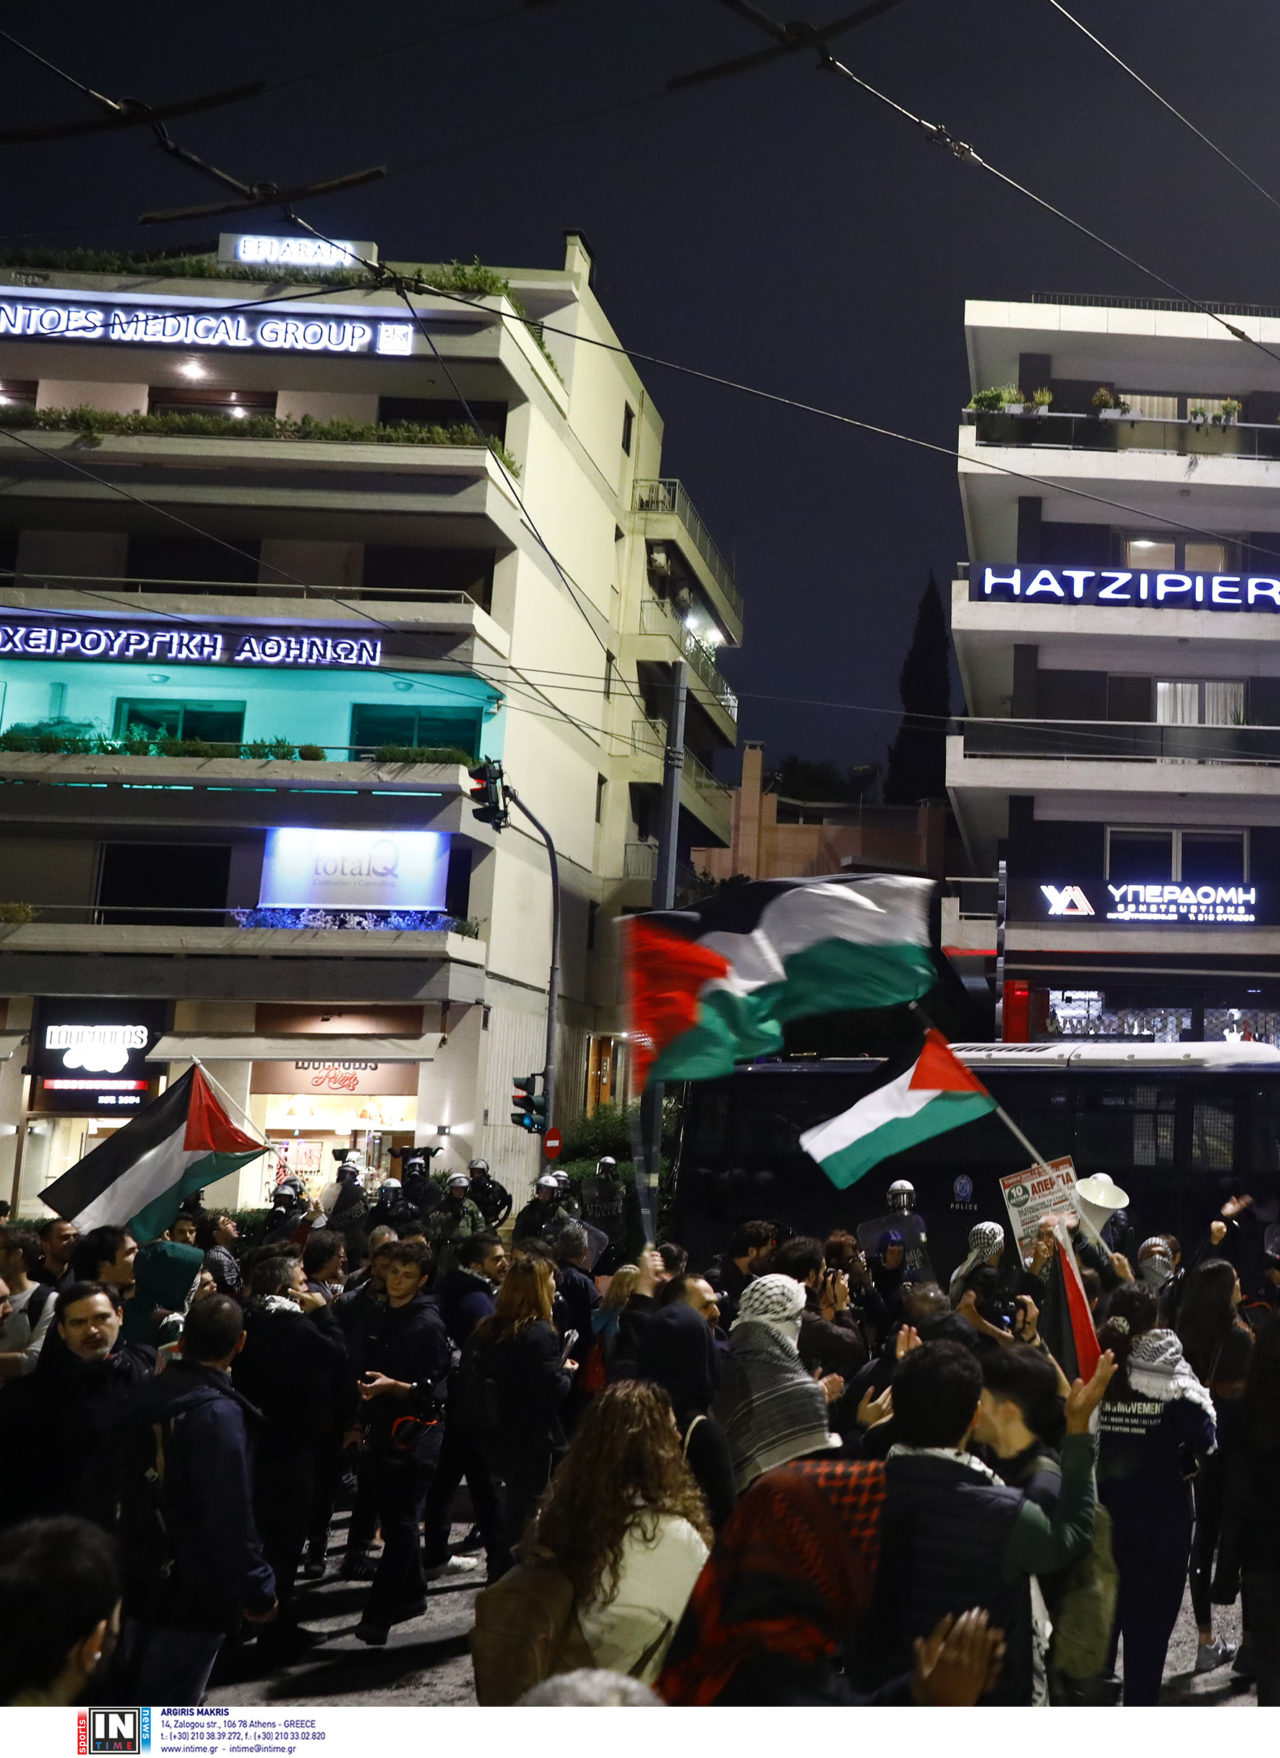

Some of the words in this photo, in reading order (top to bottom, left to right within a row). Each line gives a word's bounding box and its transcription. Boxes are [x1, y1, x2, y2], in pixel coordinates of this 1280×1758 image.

[111, 310, 252, 347] MEDICAL
[258, 320, 371, 352] GROUP
[0, 626, 222, 661] ΧΕΙΡΟΥΡΓΙΚΗ
[234, 635, 382, 665] ΑΘΗΝΩΝ
[1107, 884, 1256, 905] ΥΠΕΡΔΟΜΗ
[1117, 904, 1246, 914] CONSTRUCTIONS
[1010, 1186, 1024, 1198] 10
[950, 1203, 978, 1211] POLICE
